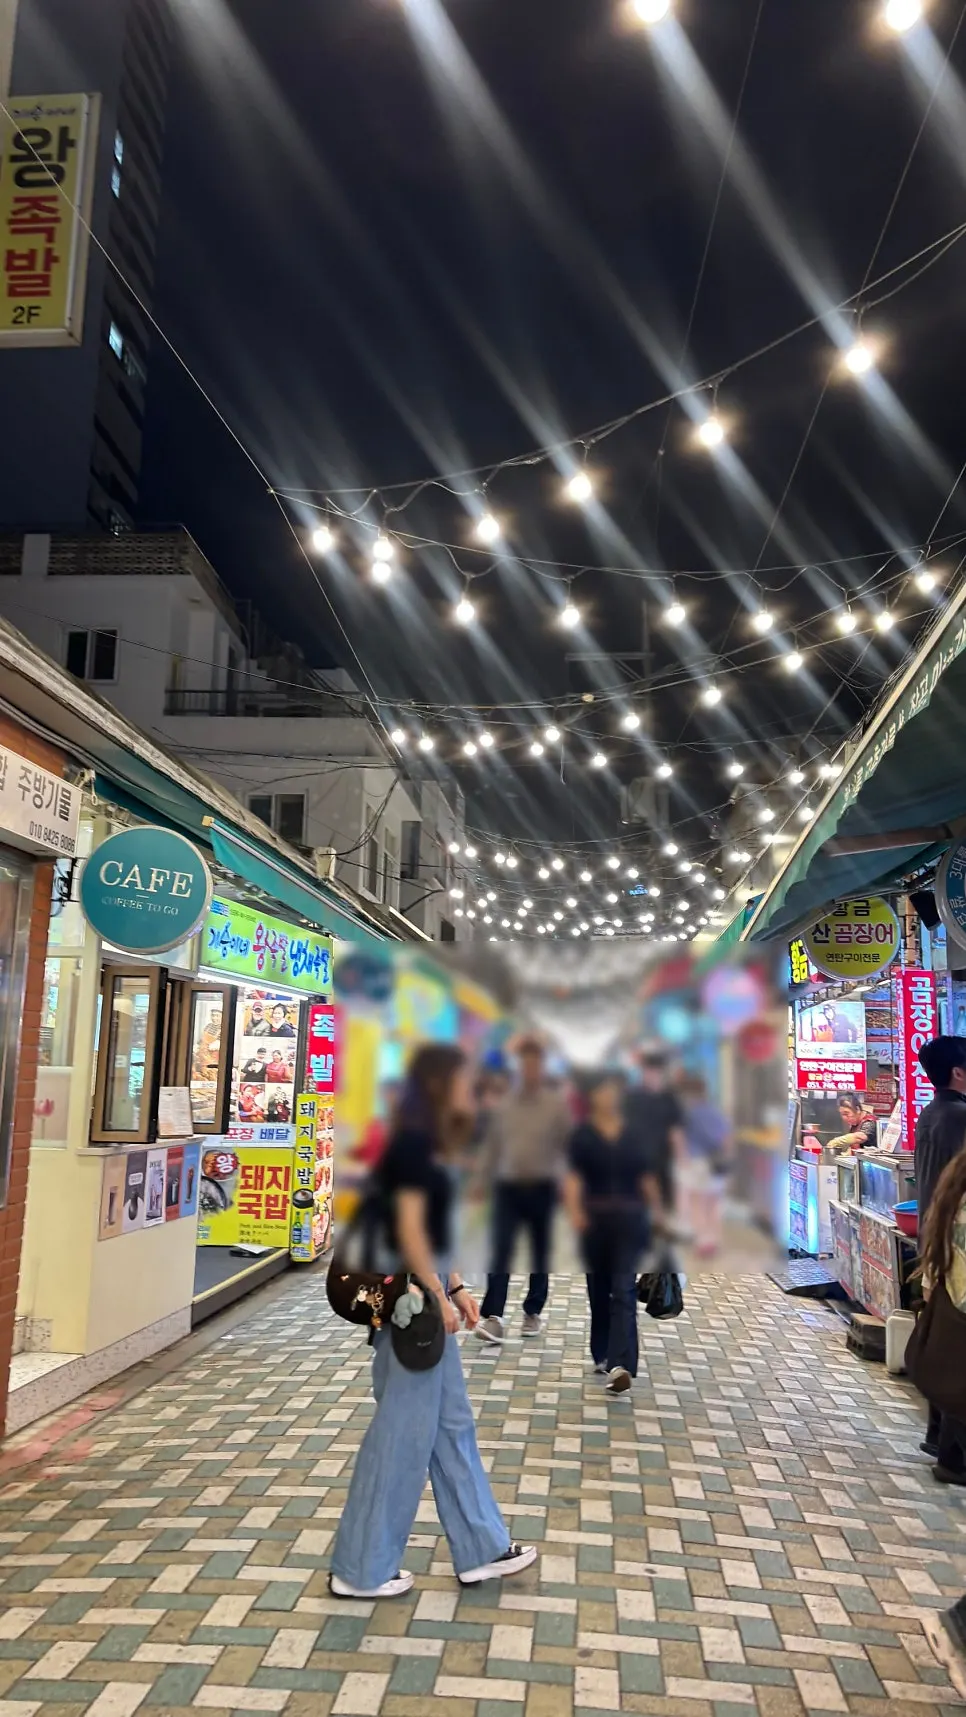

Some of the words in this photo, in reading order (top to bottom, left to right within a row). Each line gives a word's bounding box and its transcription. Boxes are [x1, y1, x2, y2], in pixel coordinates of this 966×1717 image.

[11, 305, 41, 325] 2F
[17, 765, 72, 822] 주방기물
[29, 821, 42, 839] 010
[43, 828, 60, 846] 8425
[99, 860, 194, 898] CAFE
[101, 896, 143, 910] COFFEE
[146, 903, 161, 912] TO
[163, 905, 179, 916] GO
[811, 923, 831, 944] 산
[834, 923, 894, 945] 곰장어
[825, 953, 881, 963] 연탄구이전문
[310, 1013, 335, 1082] 족발
[259, 1128, 291, 1141] 배달
[296, 1100, 316, 1186] 돼지국밥
[216, 1154, 236, 1174] 왕
[239, 1165, 291, 1191] 돼지
[237, 1193, 290, 1220] 국밥
